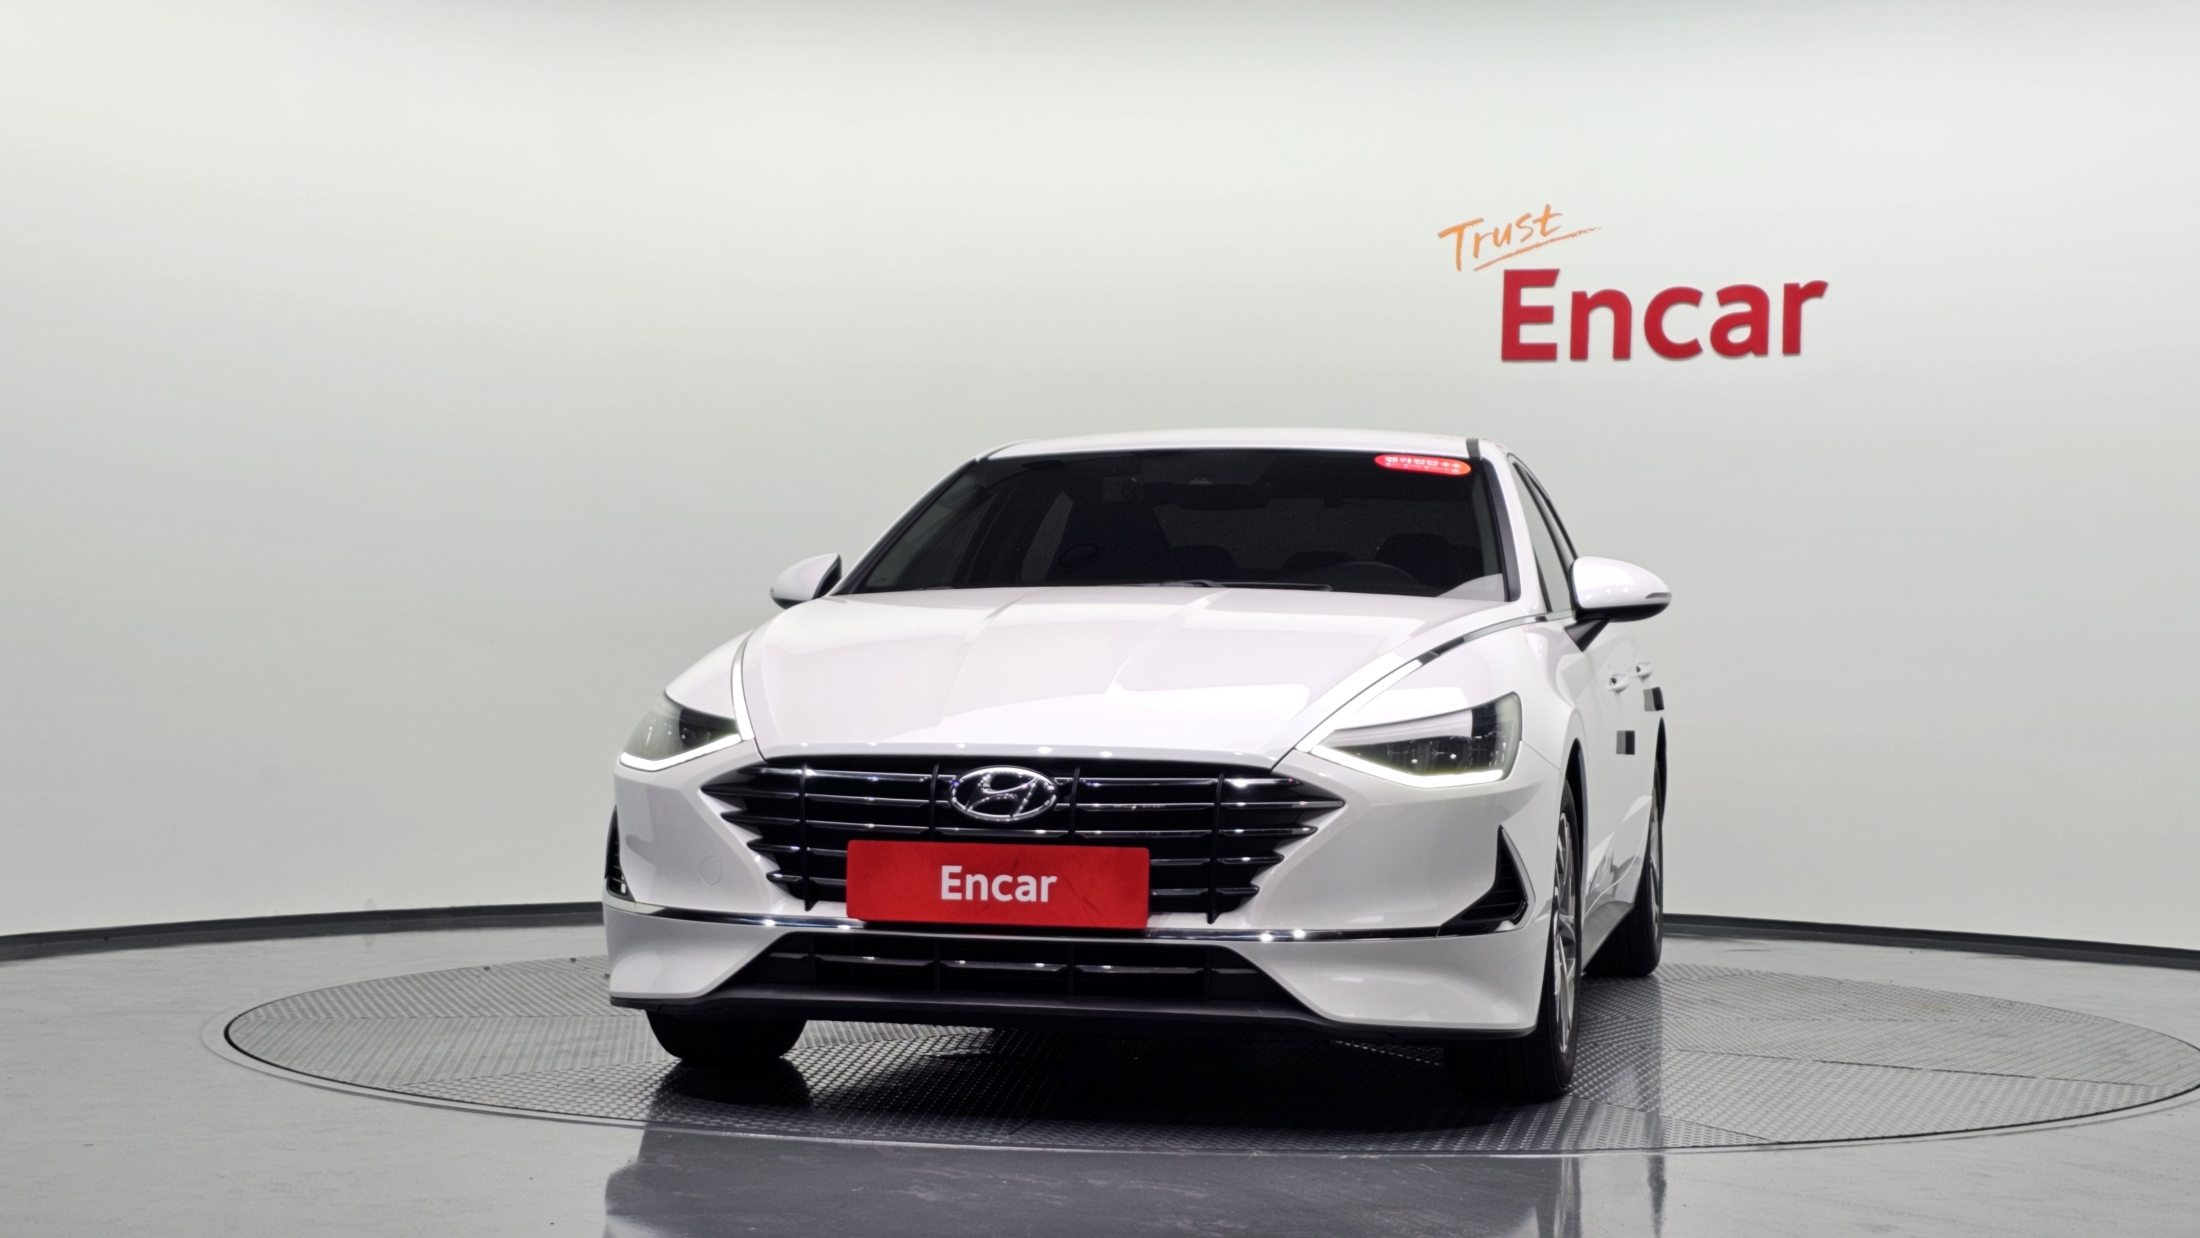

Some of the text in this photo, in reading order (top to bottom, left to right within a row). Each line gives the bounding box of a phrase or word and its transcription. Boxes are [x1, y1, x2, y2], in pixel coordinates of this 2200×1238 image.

[1437, 204, 1564, 271] Trust
[1501, 268, 1829, 362] Encar
[939, 864, 1058, 904] Encar
